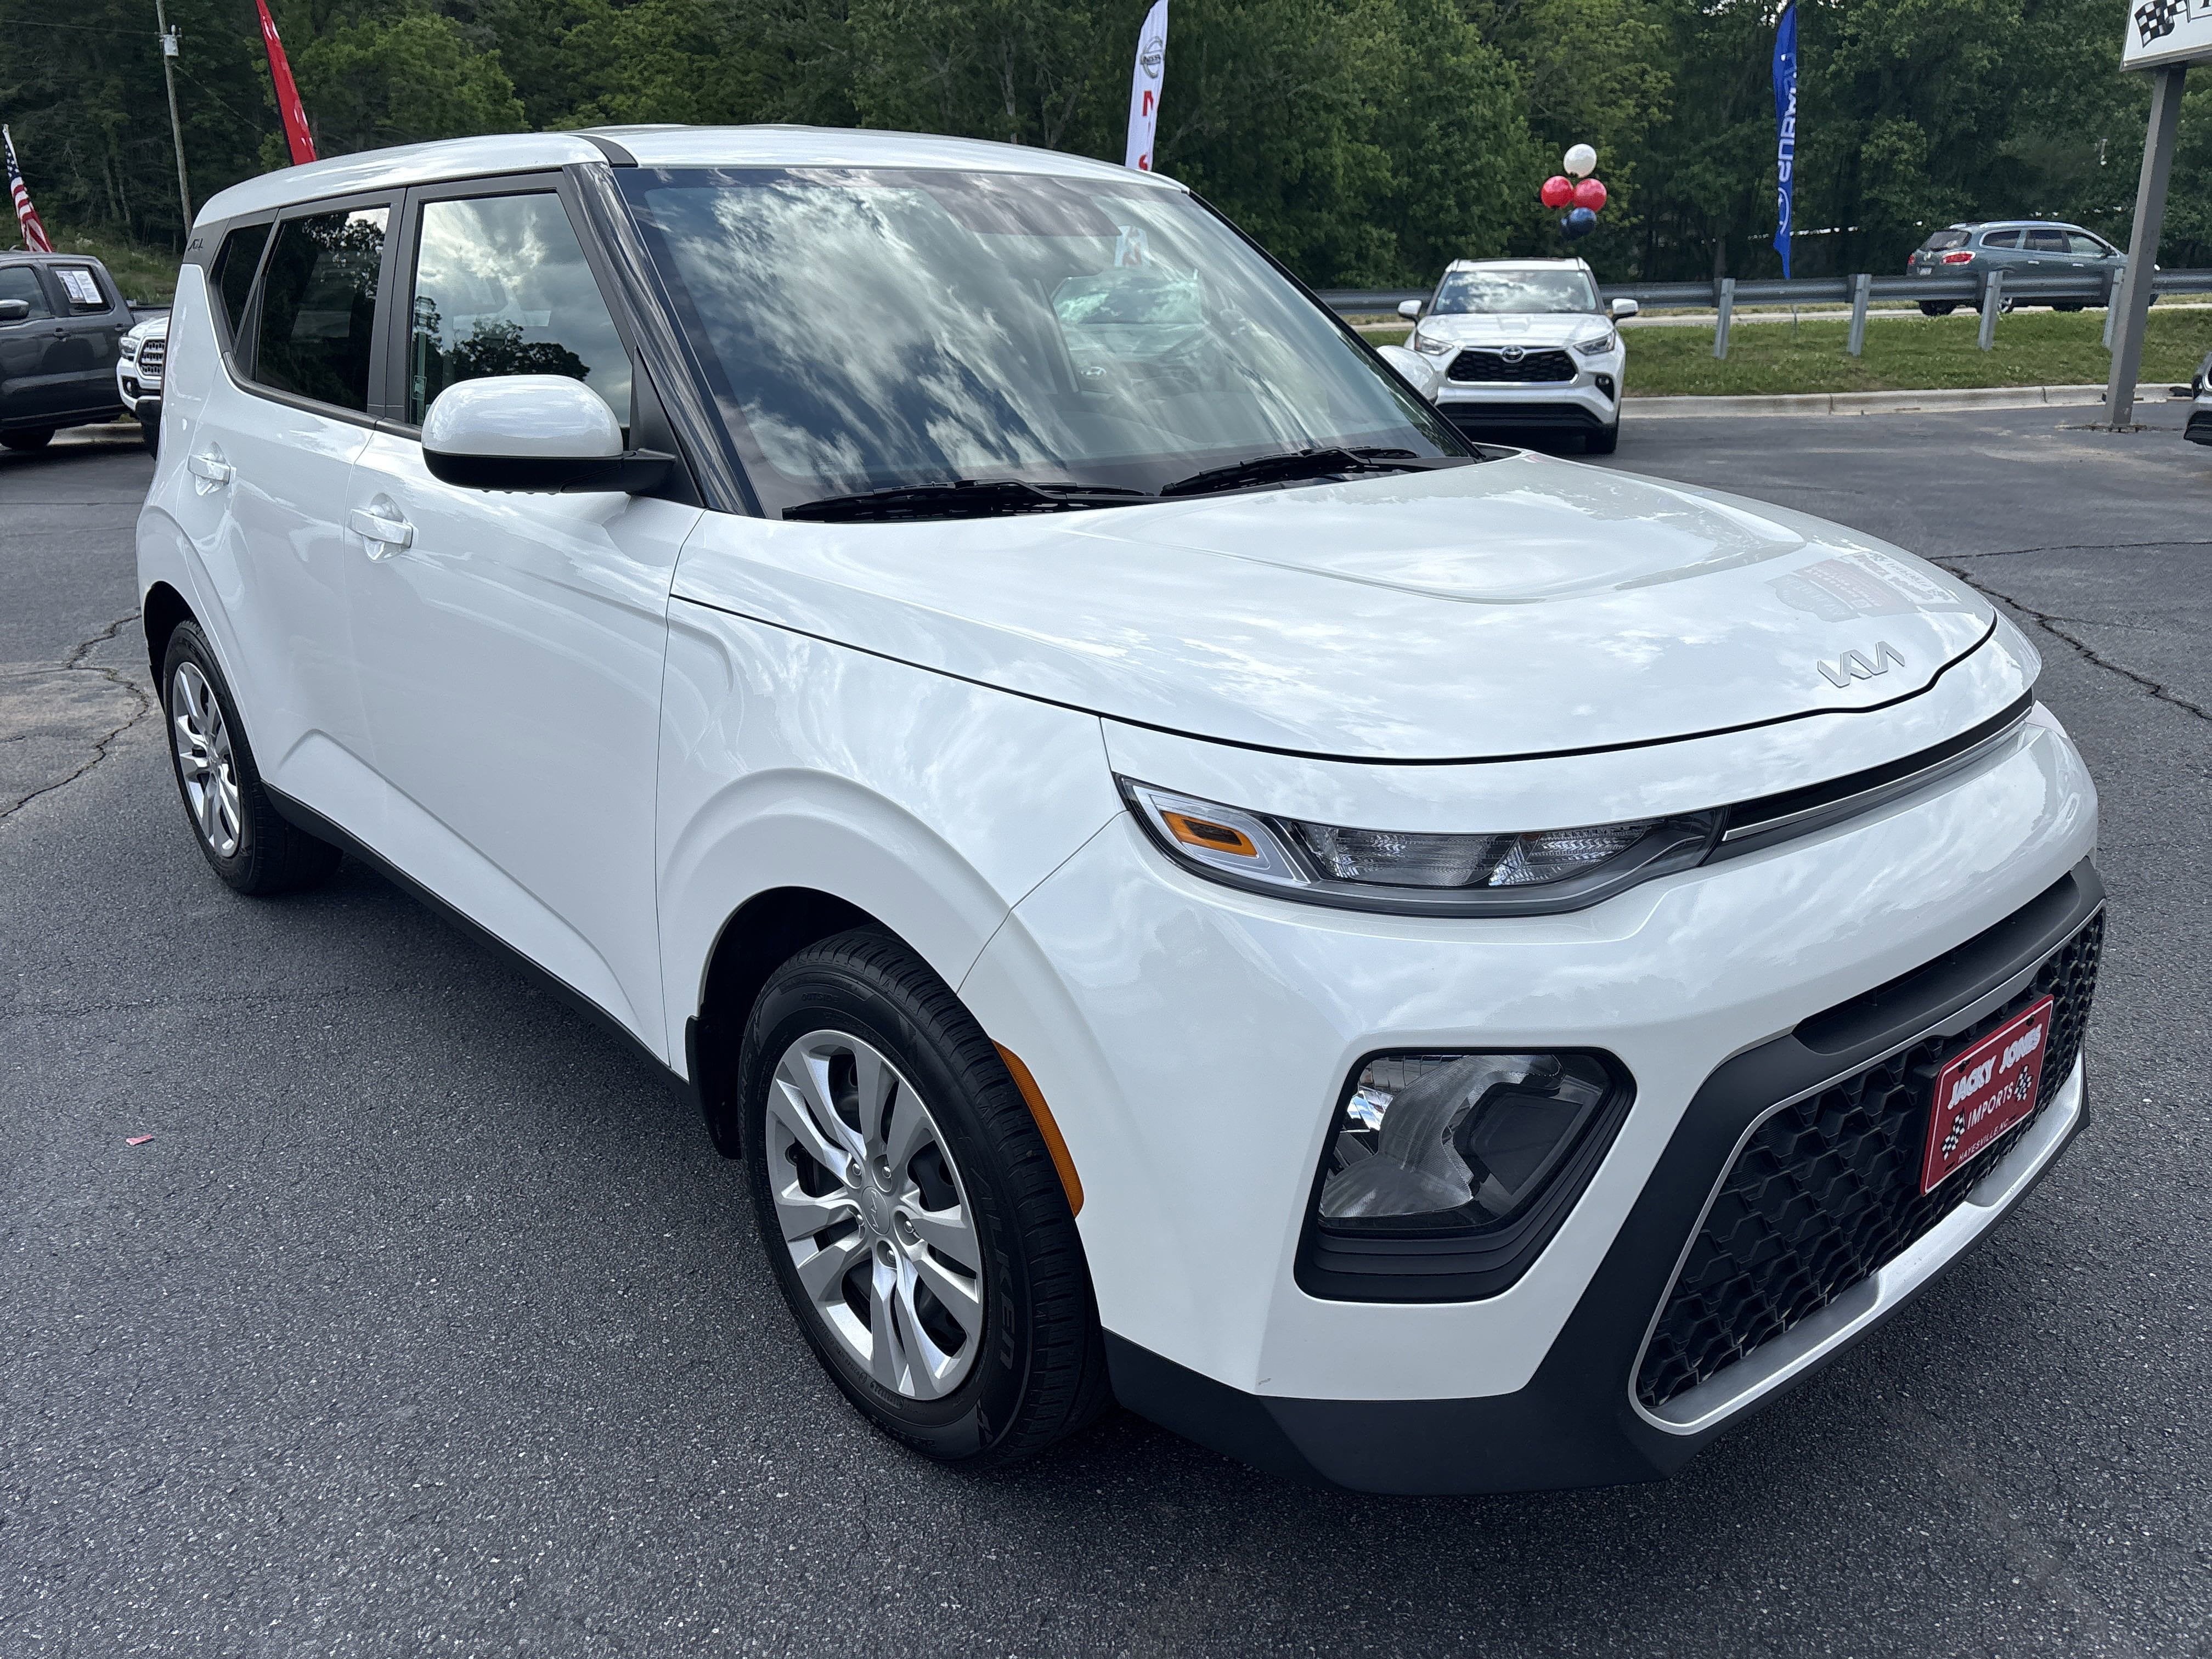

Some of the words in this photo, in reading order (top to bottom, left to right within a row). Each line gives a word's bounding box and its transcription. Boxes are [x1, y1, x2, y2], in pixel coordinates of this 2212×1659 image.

[1777, 52, 1797, 183] SUBA
[1818, 641, 1905, 688] KIA
[1948, 1055, 1997, 1110] JACKY
[1999, 1024, 2042, 1074] JONES
[1967, 1081, 2013, 1130] IMPORTS
